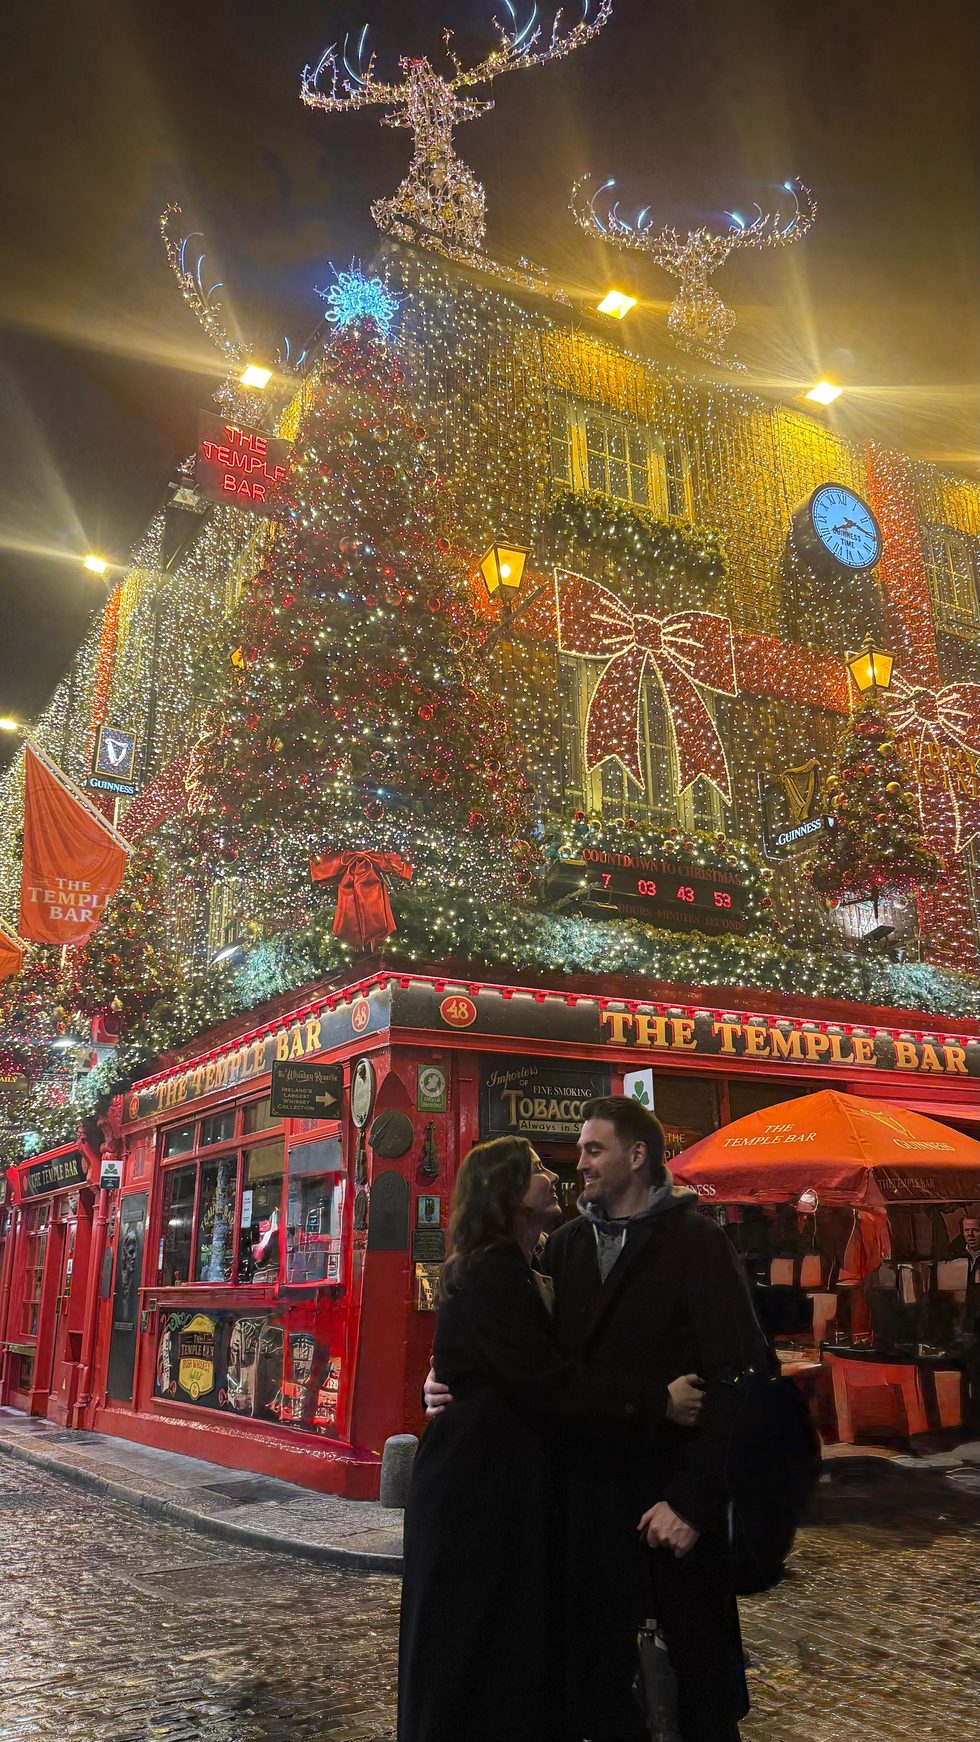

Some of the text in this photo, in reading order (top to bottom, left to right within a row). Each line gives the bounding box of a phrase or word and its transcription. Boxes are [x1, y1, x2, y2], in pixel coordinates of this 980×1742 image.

[225, 425, 267, 455] THE
[203, 441, 286, 483] TEMPLE
[224, 474, 265, 502] BAR
[840, 538, 855, 548] TIME
[90, 778, 134, 794] GUINNESS
[779, 819, 821, 845] GUINNESS
[581, 848, 742, 885] COUNTDOWN TO CHRISTMAS
[55, 878, 92, 892] THE
[602, 873, 731, 908] 7 03 43 53
[49, 905, 96, 923] BAR
[619, 903, 747, 931] HOURS MINUTES SECONDS
[354, 1004, 368, 1027] 48
[446, 999, 469, 1020] 48
[601, 1010, 970, 1074] THE TEMPLE BAR
[156, 1020, 322, 1110] THE TEMPLE BAR
[486, 1066, 538, 1088] Importers
[533, 1086, 592, 1097] FINE SMOKING
[277, 1103, 315, 1111] COLLECTION
[501, 1089, 583, 1128] TOBACC
[520, 1121, 555, 1131] Always
[561, 1122, 570, 1131] in
[764, 1124, 796, 1134] THE
[723, 1132, 817, 1148] TEMPLE BAR
[893, 1139, 955, 1152] GUINNESS
[64, 1160, 78, 1178] BAR
[181, 1344, 202, 1356] TEMPLE
